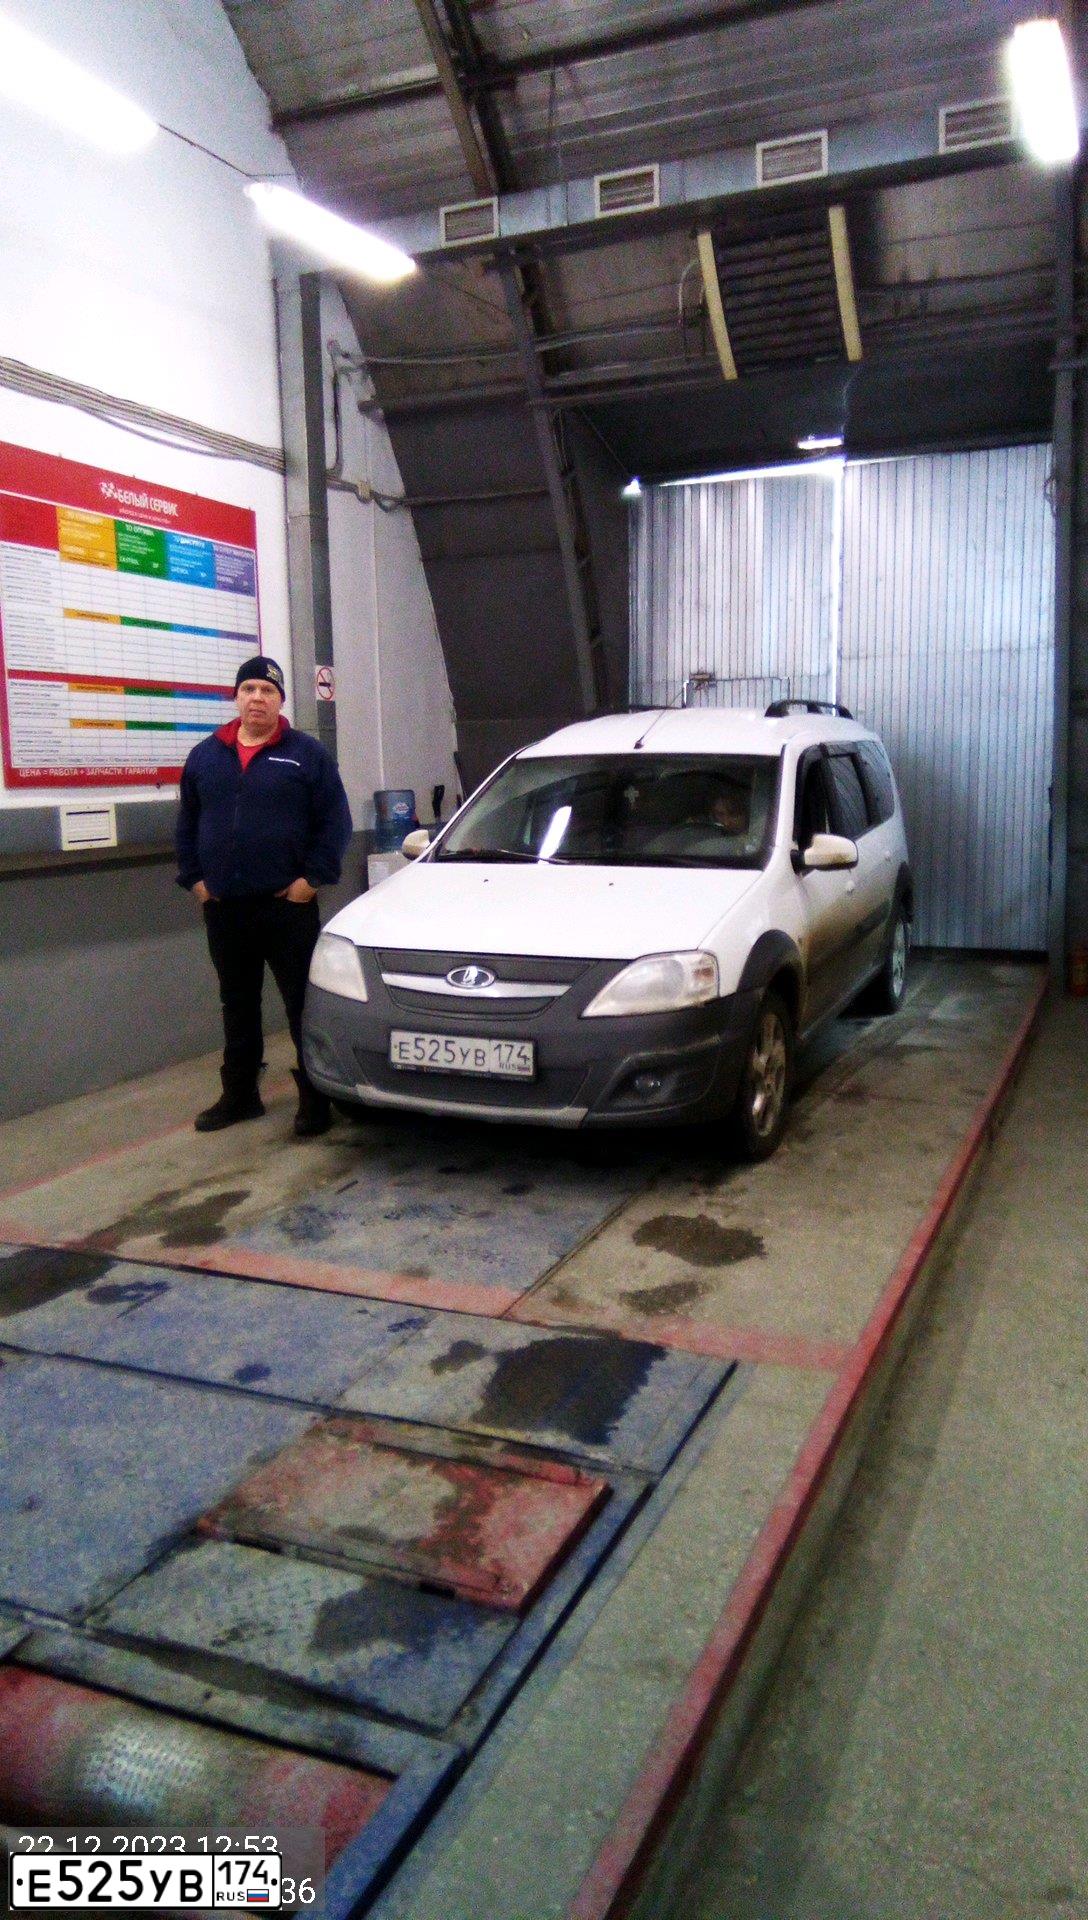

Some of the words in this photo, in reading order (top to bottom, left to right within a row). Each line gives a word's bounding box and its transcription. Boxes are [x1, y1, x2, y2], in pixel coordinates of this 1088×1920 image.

[117, 489, 149, 509] БЕЛЫЙ
[19, 768, 41, 778] ЦЕНА
[49, 768, 79, 777] РАБОТА
[125, 767, 158, 776] ГАРАНТИЯ
[494, 1044, 530, 1064] 174
[500, 1063, 516, 1071] RUS
